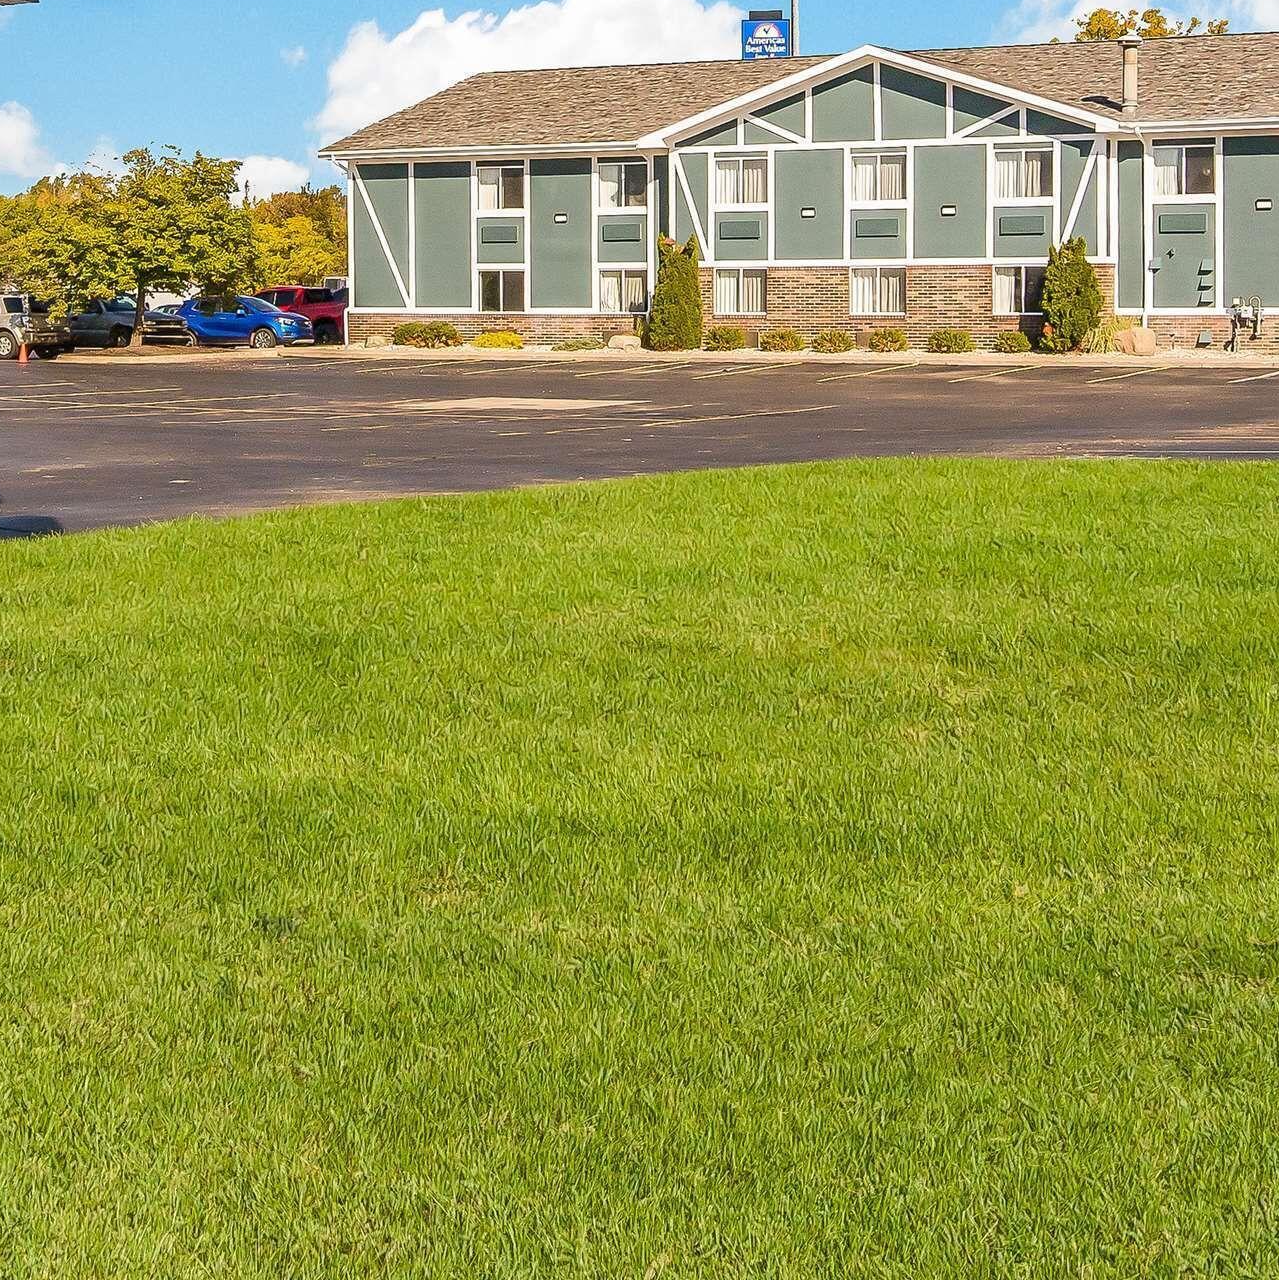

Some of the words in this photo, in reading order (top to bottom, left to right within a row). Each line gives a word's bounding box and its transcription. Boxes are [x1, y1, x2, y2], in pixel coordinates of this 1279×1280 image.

[746, 37, 785, 45] Americas
[745, 45, 762, 53] Best
[764, 45, 786, 53] Value
